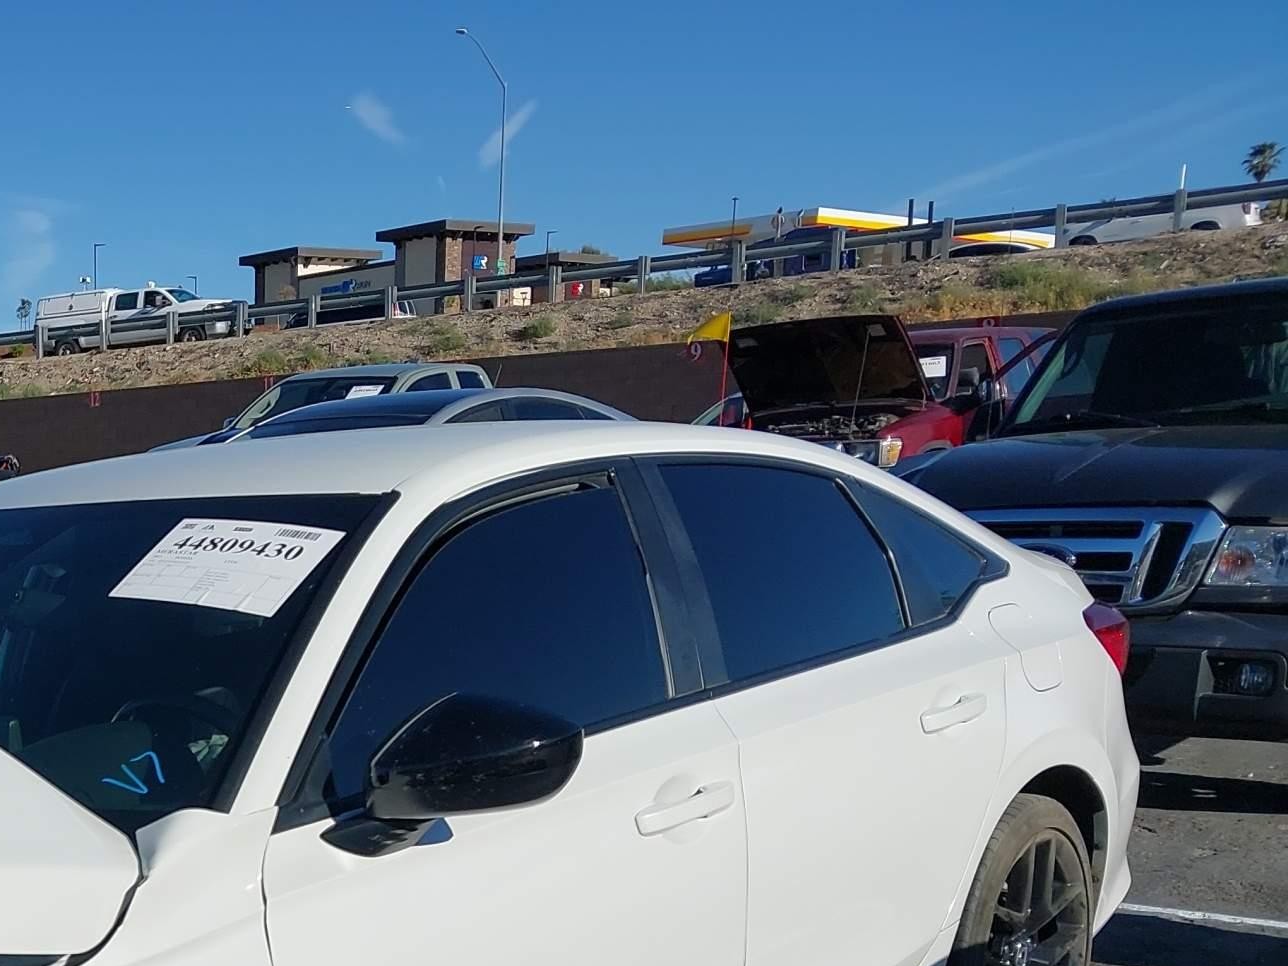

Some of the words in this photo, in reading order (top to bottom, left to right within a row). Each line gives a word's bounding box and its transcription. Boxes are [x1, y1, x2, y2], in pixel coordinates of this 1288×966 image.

[690, 342, 702, 361] 9
[90, 391, 101, 407] 12
[173, 535, 305, 561] 44809430
[101, 751, 166, 794] V7
